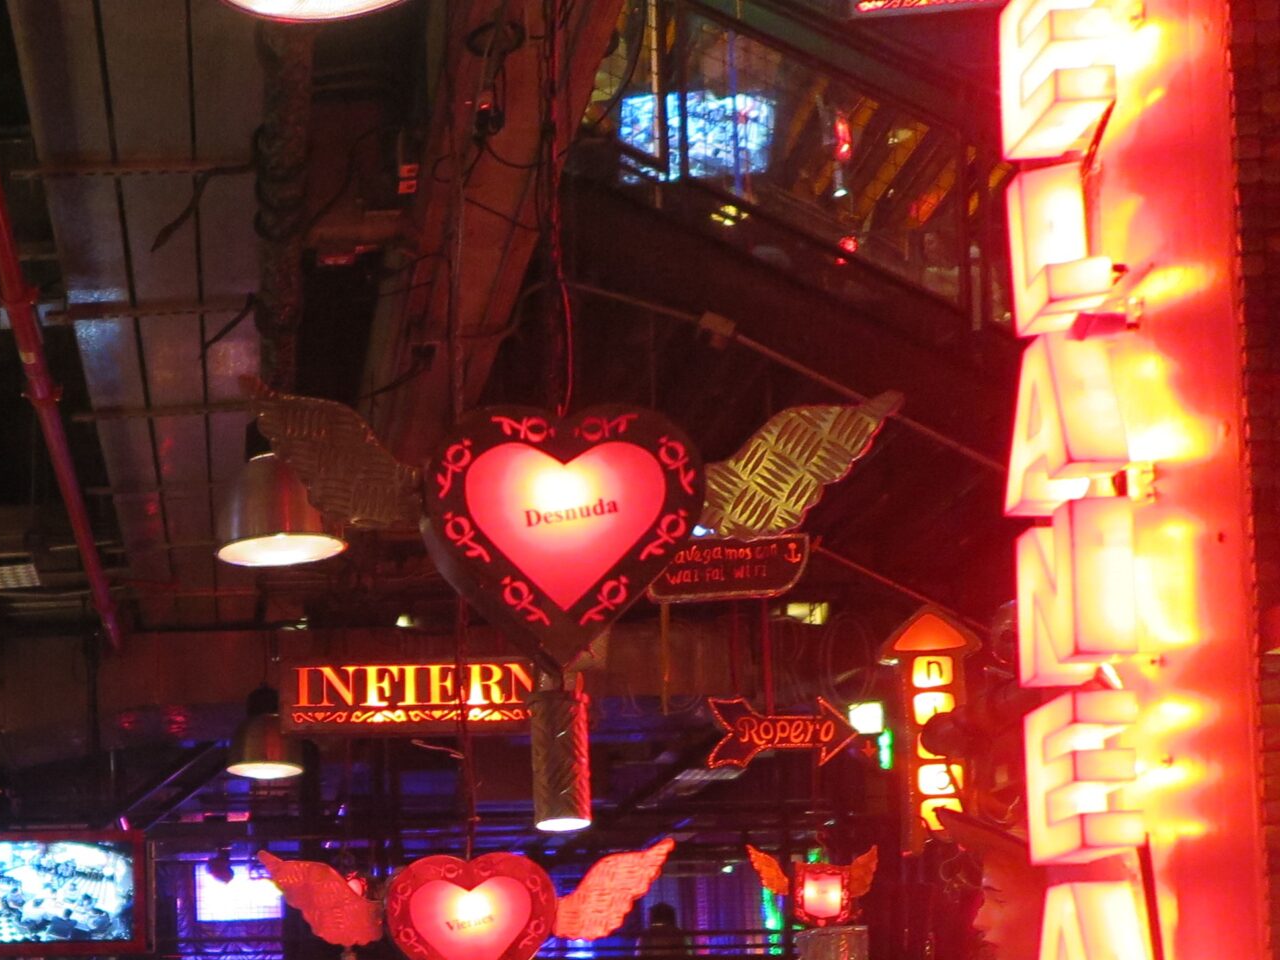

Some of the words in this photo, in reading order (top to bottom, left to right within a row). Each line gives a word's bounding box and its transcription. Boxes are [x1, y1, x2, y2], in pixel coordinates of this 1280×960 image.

[524, 495, 620, 530] Desnuda
[673, 544, 753, 565] avegamos
[737, 715, 836, 745] Ropero
[444, 913, 495, 932] Viernes
